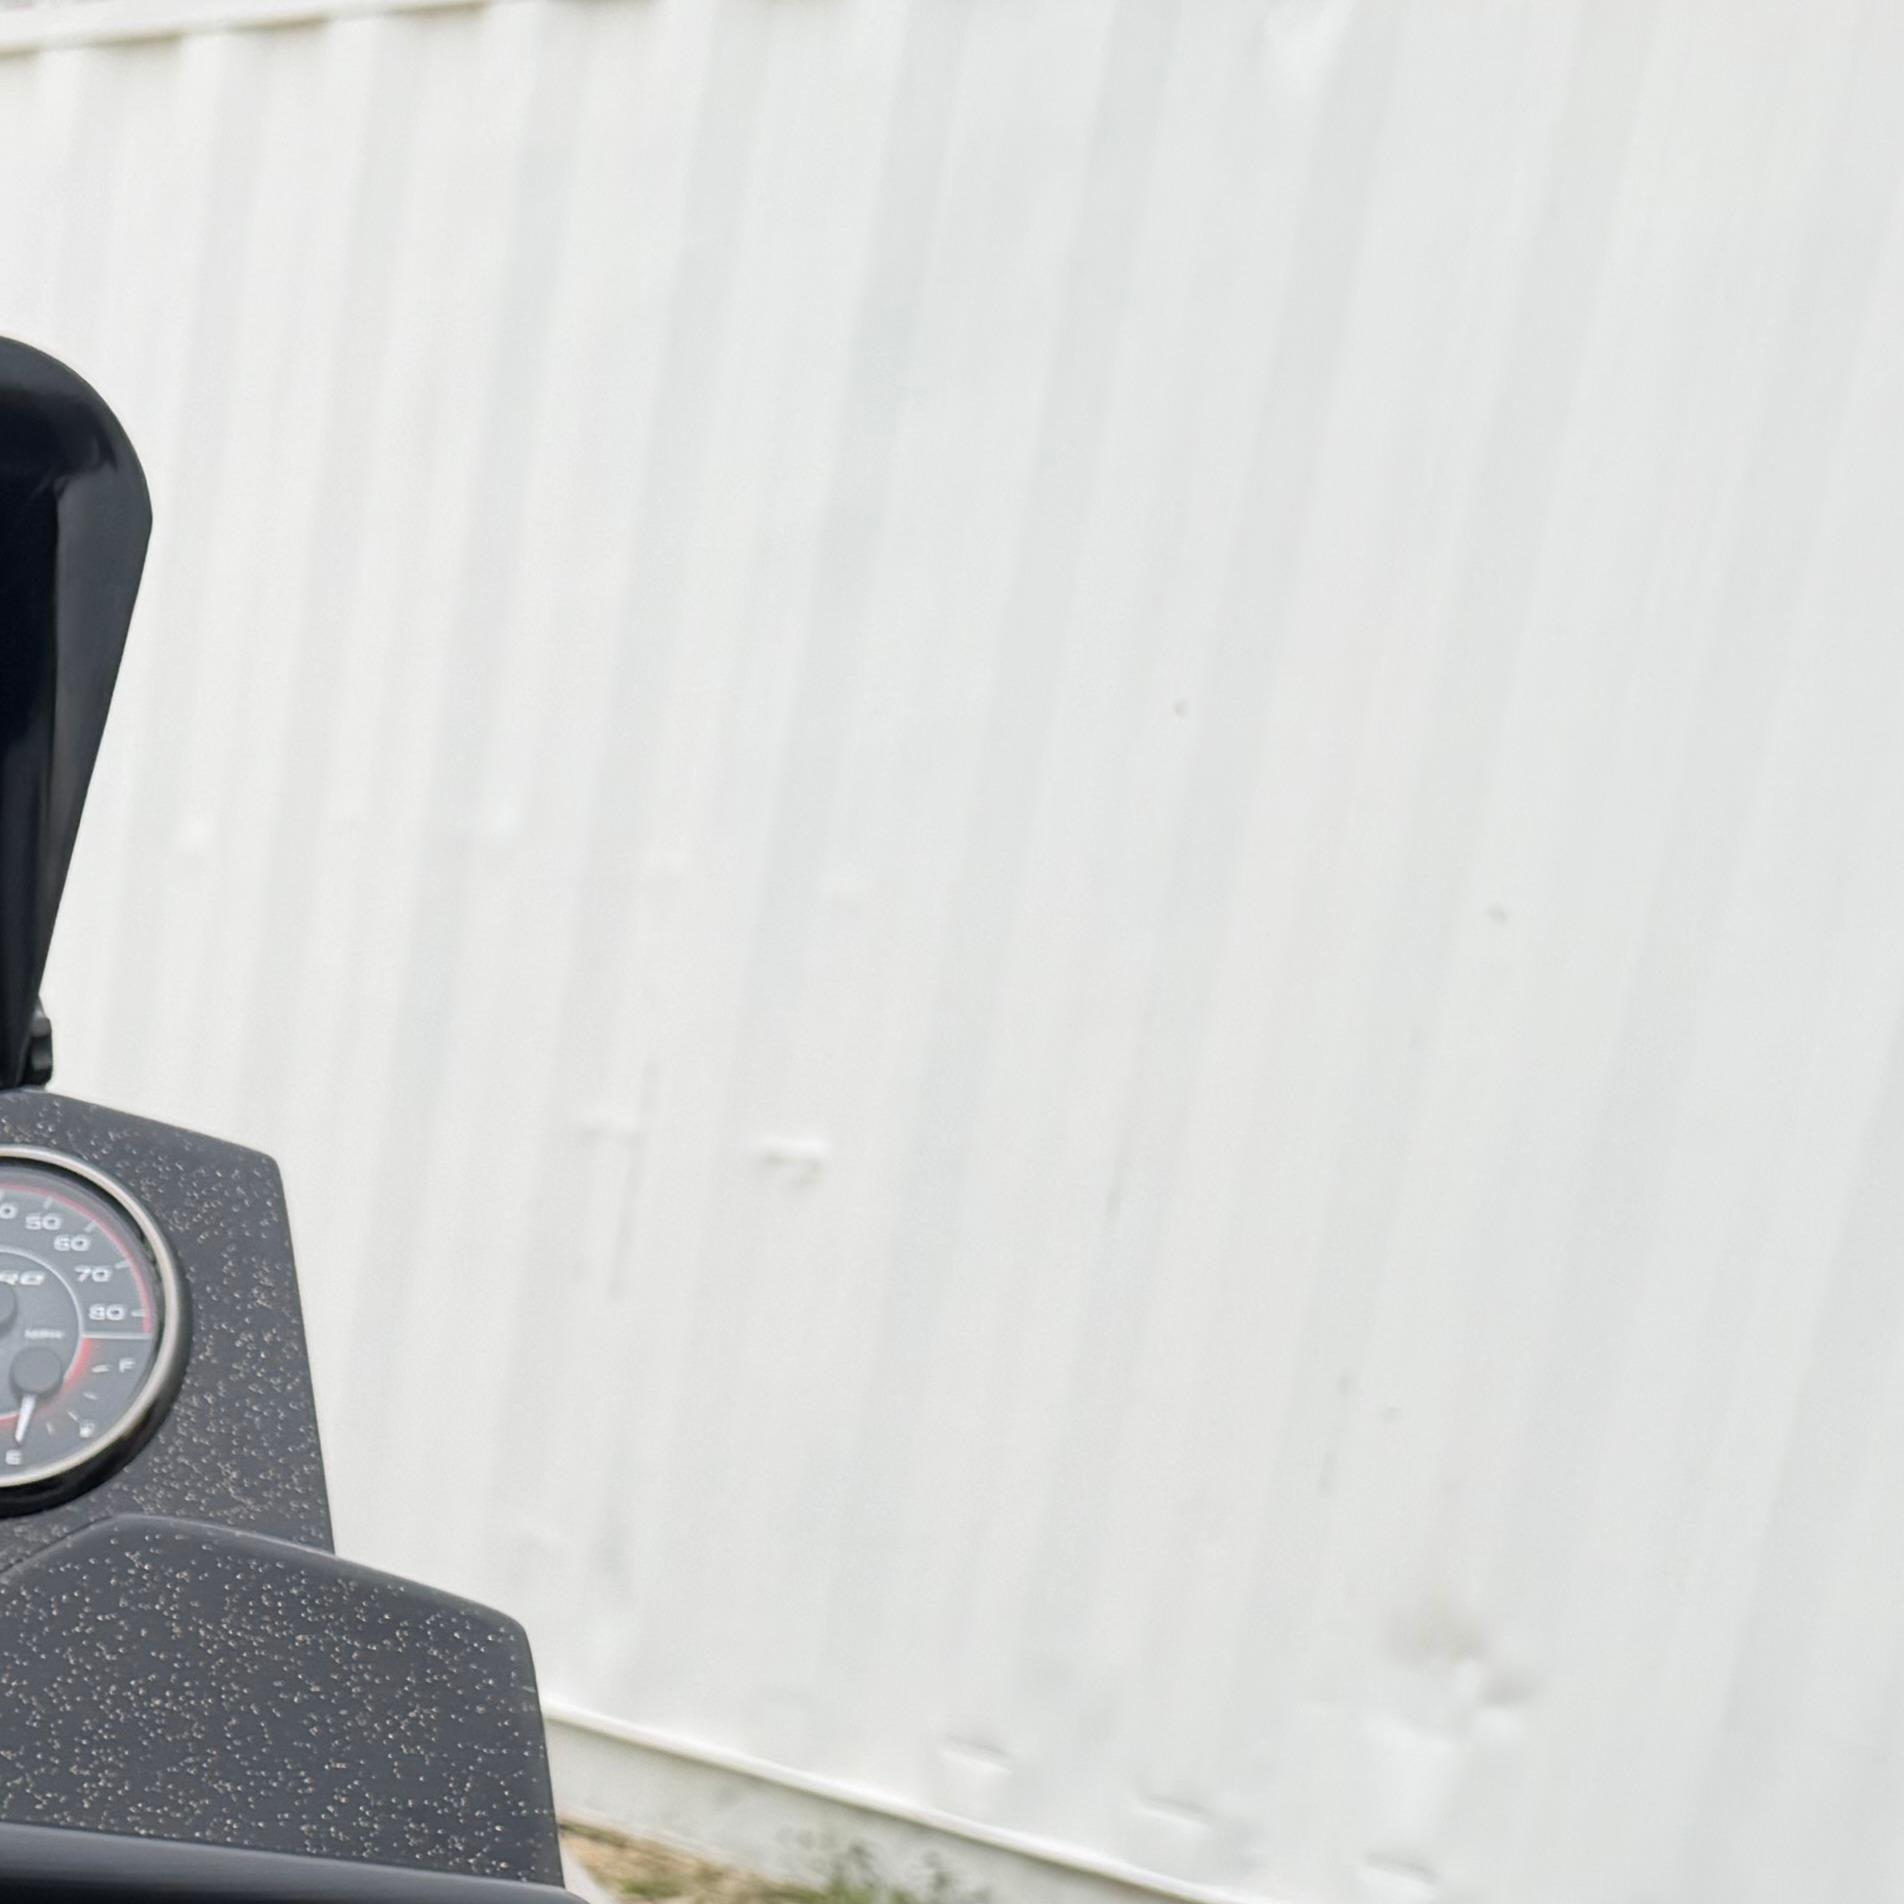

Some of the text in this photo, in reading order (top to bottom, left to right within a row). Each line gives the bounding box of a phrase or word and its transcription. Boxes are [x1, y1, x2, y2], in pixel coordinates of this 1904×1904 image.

[25, 1213, 63, 1231] 50
[53, 1234, 91, 1252] 60
[75, 1265, 113, 1283] 70
[88, 1304, 126, 1321] 80
[119, 1358, 136, 1373] F
